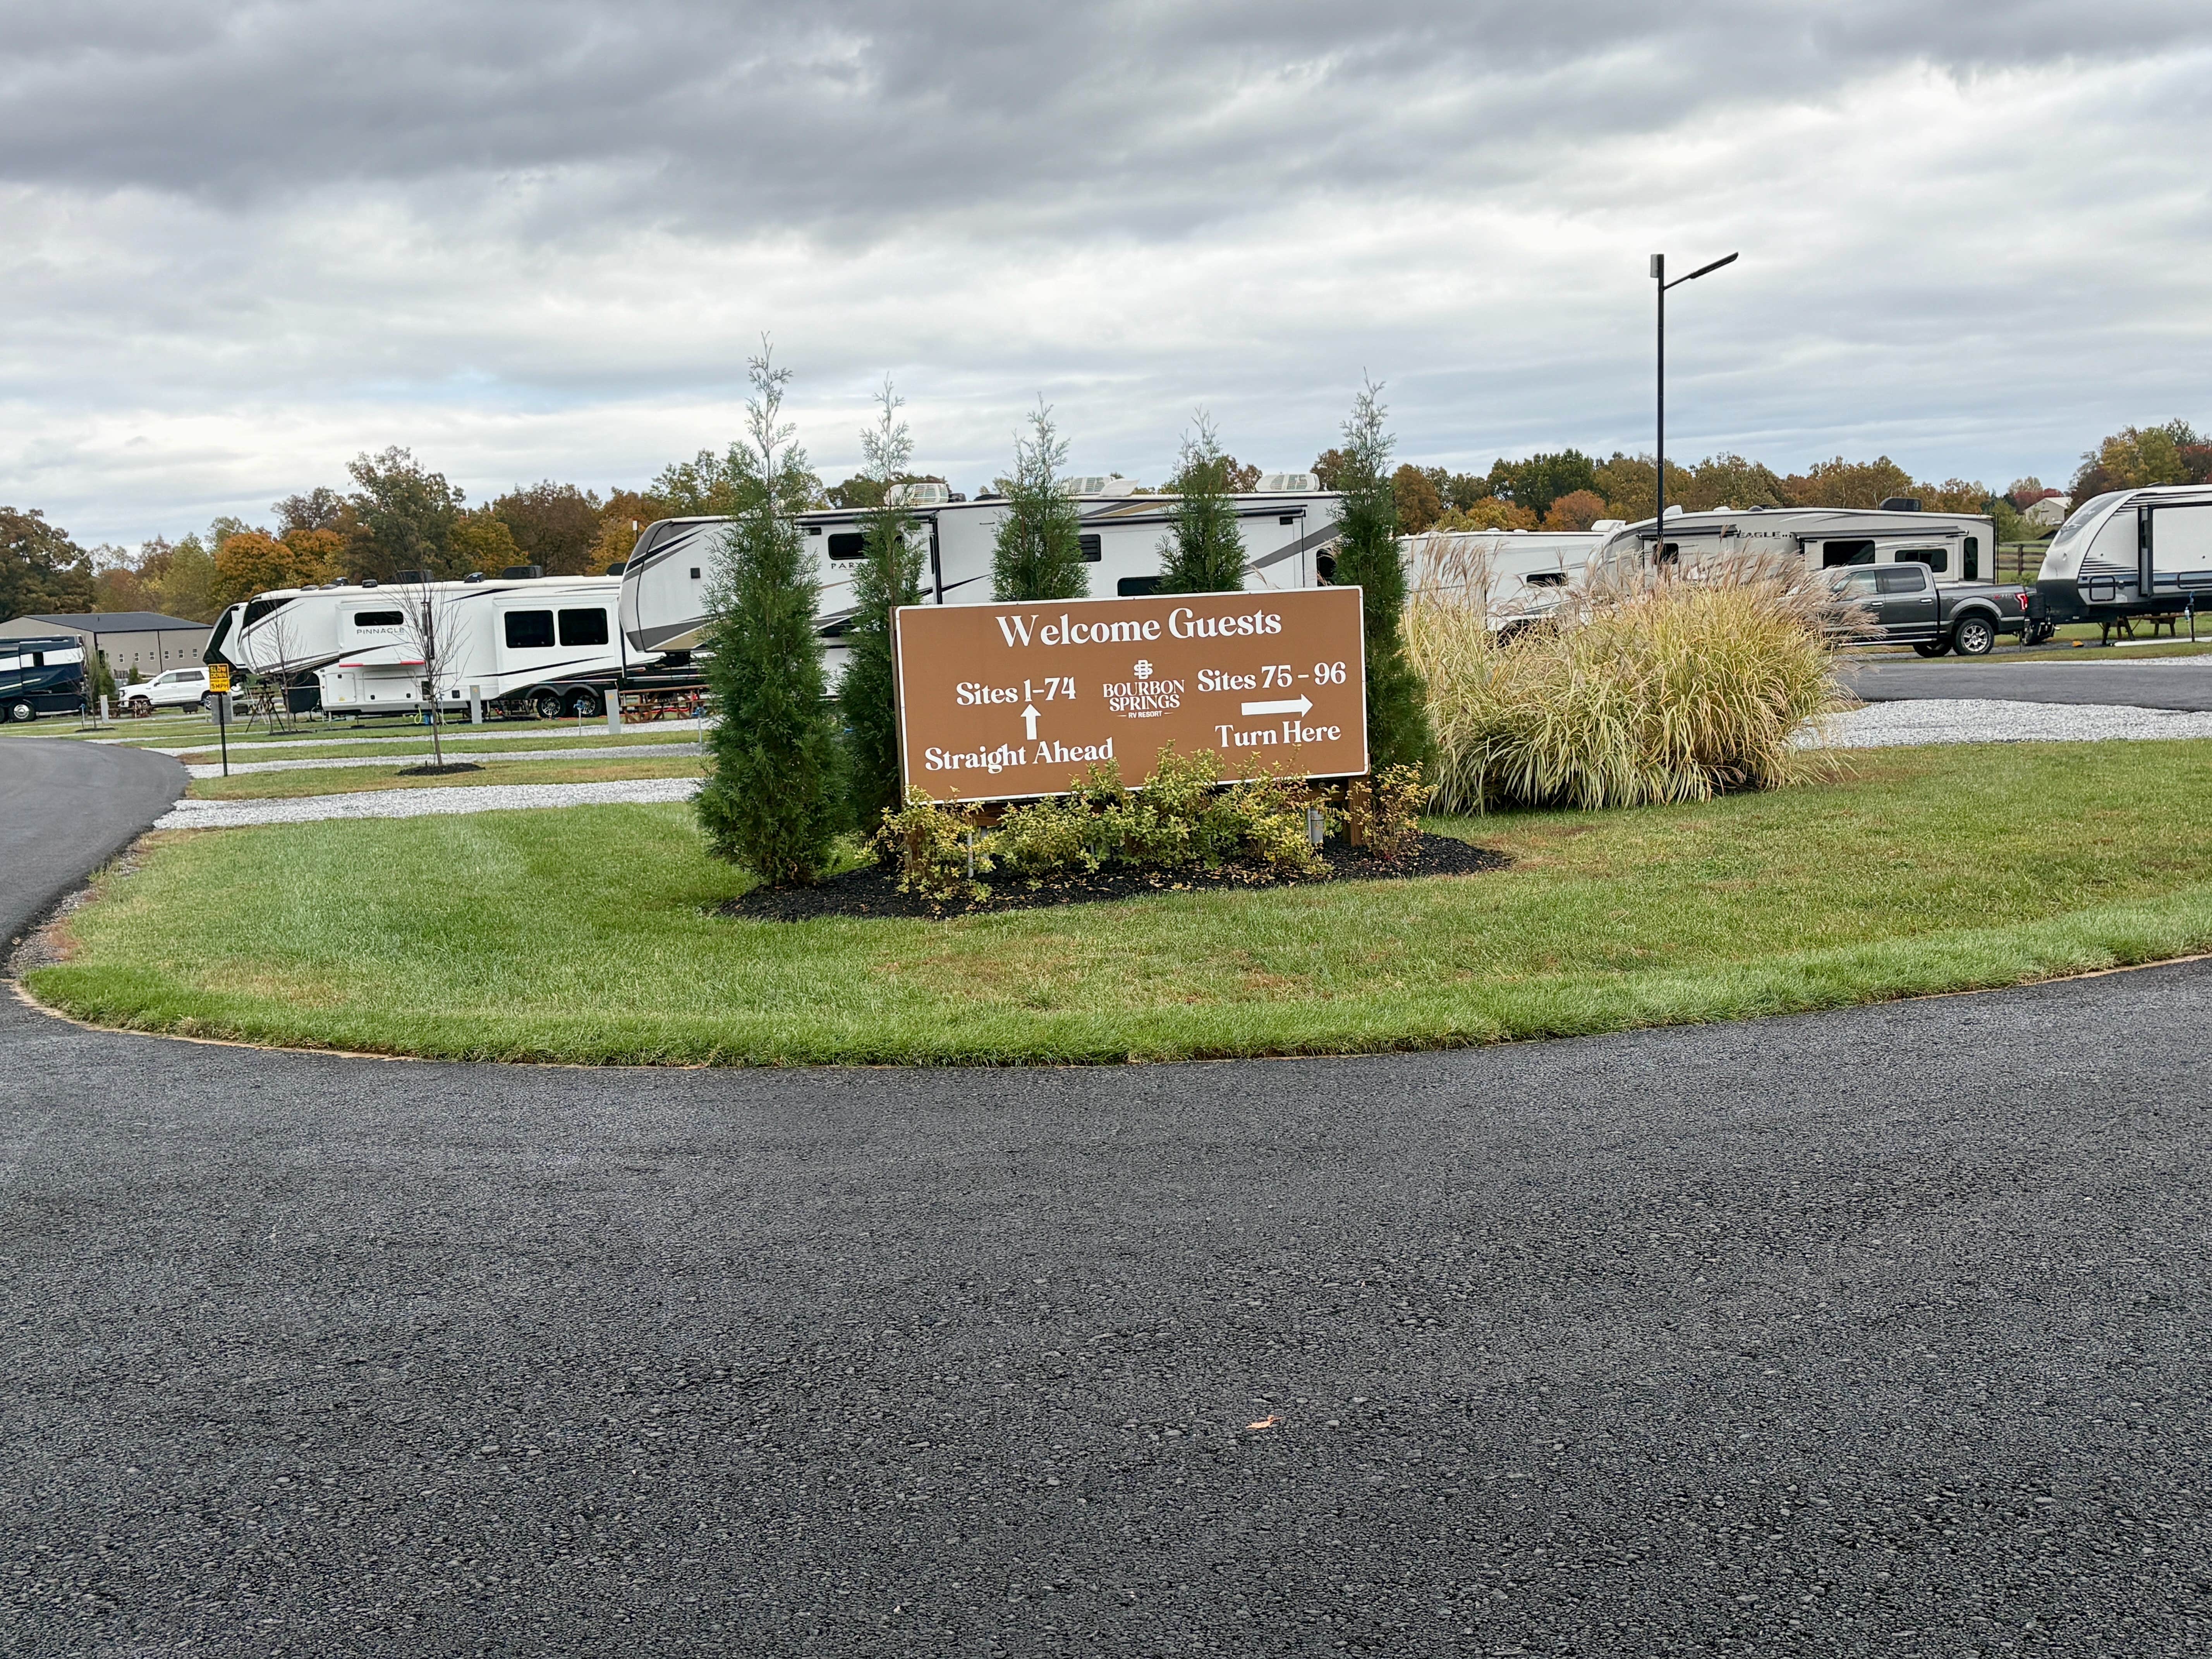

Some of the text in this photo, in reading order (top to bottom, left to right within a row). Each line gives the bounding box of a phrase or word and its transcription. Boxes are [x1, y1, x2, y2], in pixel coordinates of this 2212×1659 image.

[995, 608, 1281, 647] Welcome Guests
[956, 677, 1076, 705] Sites 1-74
[1103, 679, 1185, 697] BOURBON
[1197, 669, 1256, 692] Sites
[1109, 694, 1180, 711] SPRINGS
[1215, 720, 1341, 747] Turn Here
[925, 737, 1113, 774] Straight Ahead
